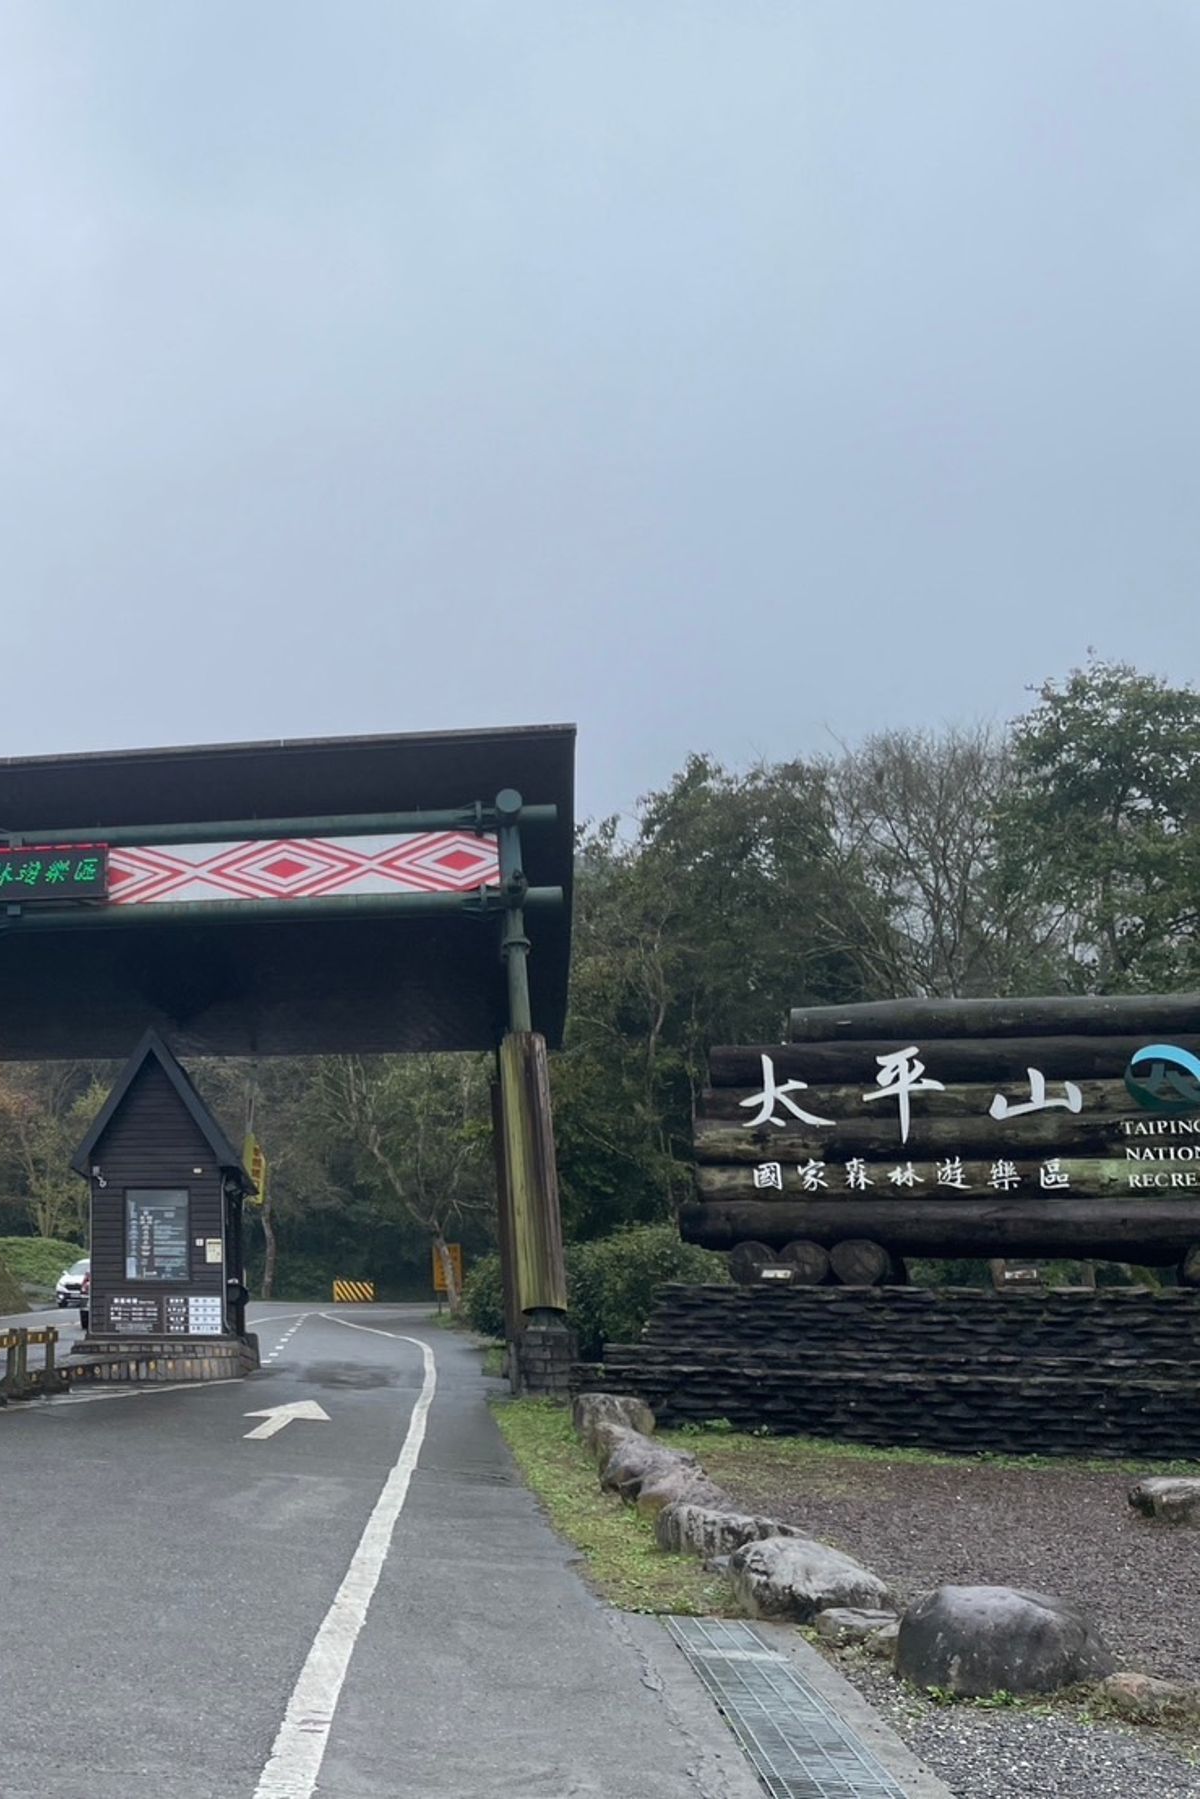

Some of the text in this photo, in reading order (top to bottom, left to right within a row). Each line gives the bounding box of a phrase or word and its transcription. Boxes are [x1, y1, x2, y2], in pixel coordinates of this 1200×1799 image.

[739, 1046, 1082, 1144] 太平山
[753, 1156, 1070, 1191] 國家森林遊樂區
[1129, 1172, 1200, 1189] RECRE
